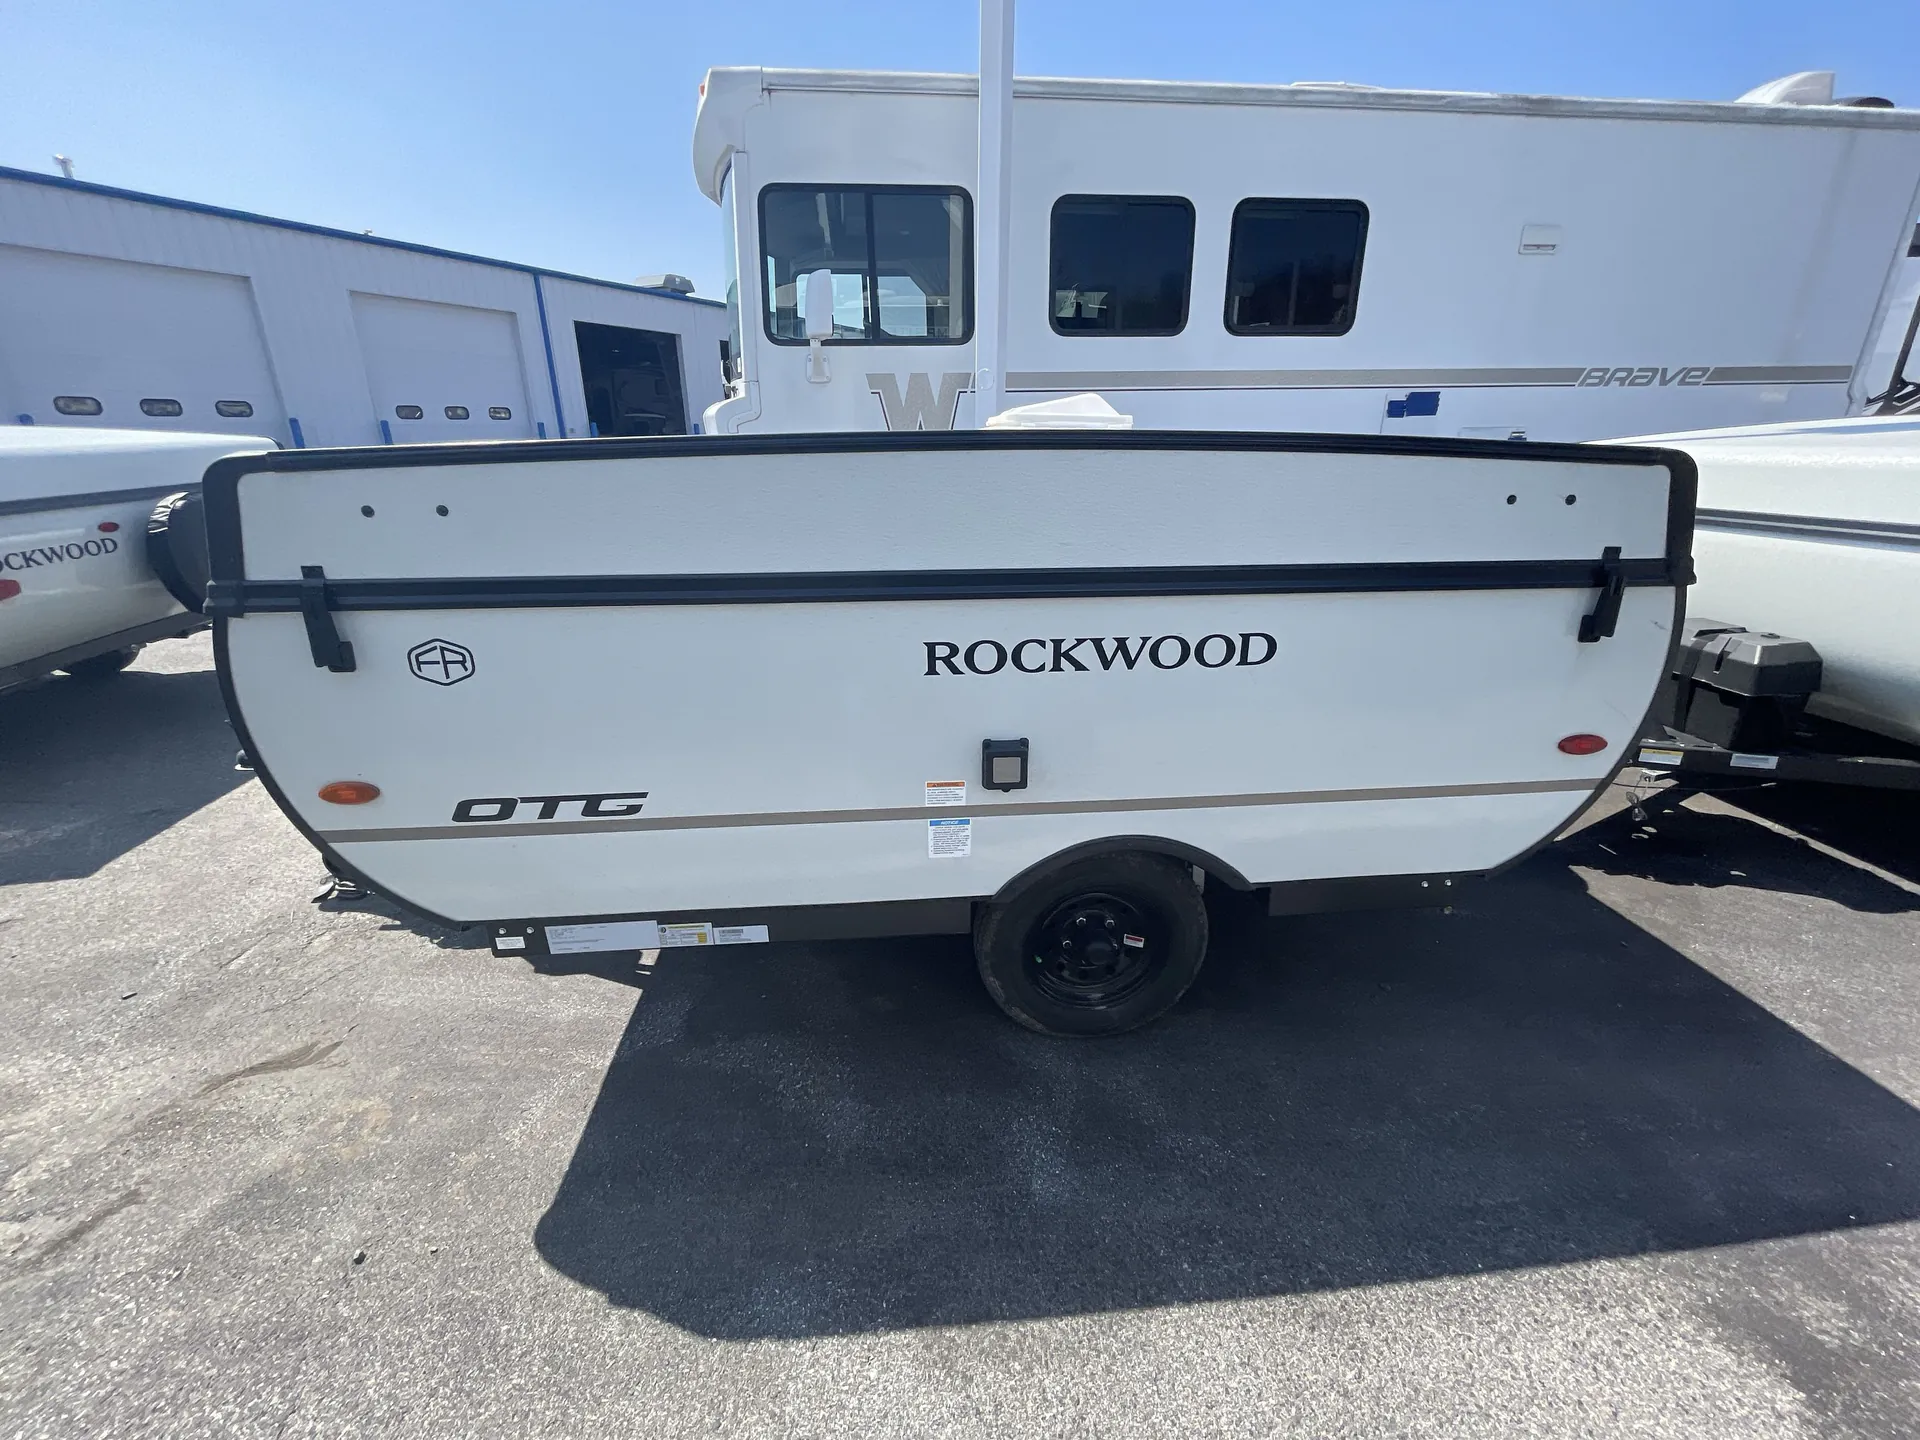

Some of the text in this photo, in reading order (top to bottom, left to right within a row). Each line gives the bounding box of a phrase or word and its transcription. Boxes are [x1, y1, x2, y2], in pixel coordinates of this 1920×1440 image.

[1577, 367, 1710, 387] BRAVE
[0, 537, 118, 573] CKWOOD
[414, 643, 469, 681] FR
[923, 632, 1278, 676] ROCKWOOD
[451, 791, 649, 823] OTG
